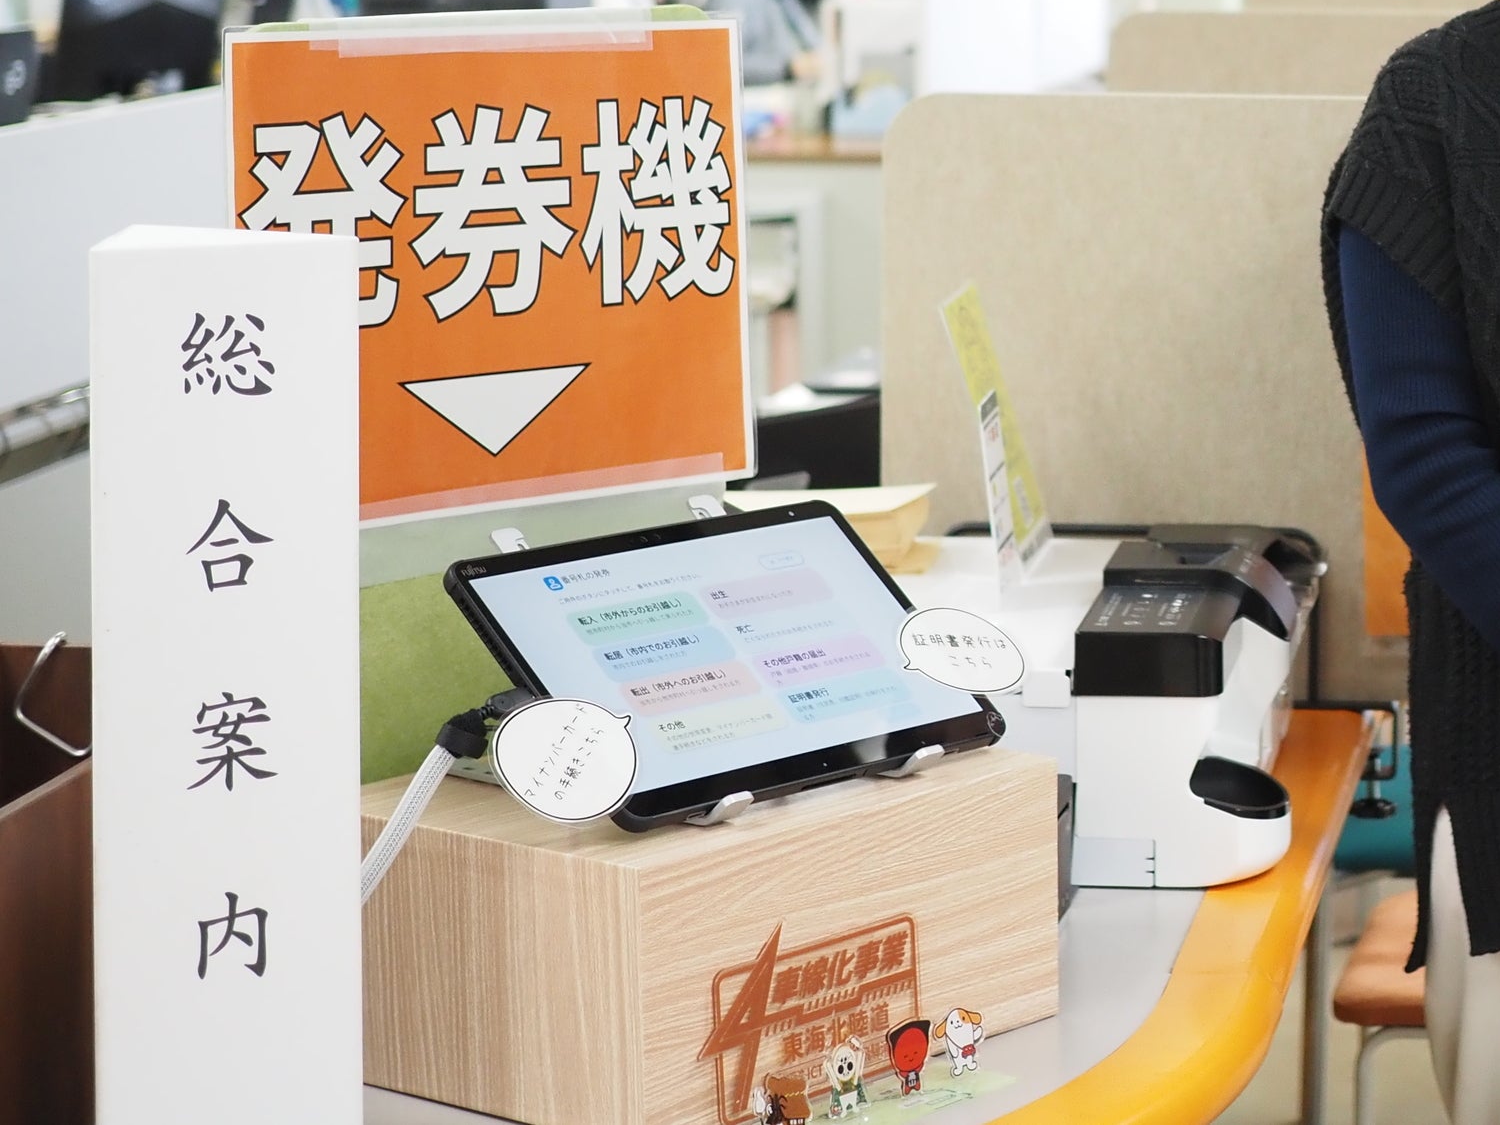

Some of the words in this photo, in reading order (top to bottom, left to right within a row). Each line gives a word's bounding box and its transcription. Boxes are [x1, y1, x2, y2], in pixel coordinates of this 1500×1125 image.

[240, 96, 736, 327] 発券機
[708, 589, 729, 600] 出生
[734, 623, 755, 634] 死亡
[180, 313, 278, 980] 総合案内
[912, 634, 1006, 649] 証明書発行は
[948, 655, 992, 668] こちら
[787, 687, 831, 703] 証明書発行
[656, 720, 686, 733] その他
[525, 701, 586, 799] マイナンバーカード
[782, 1002, 889, 1064] 東海北陸道
